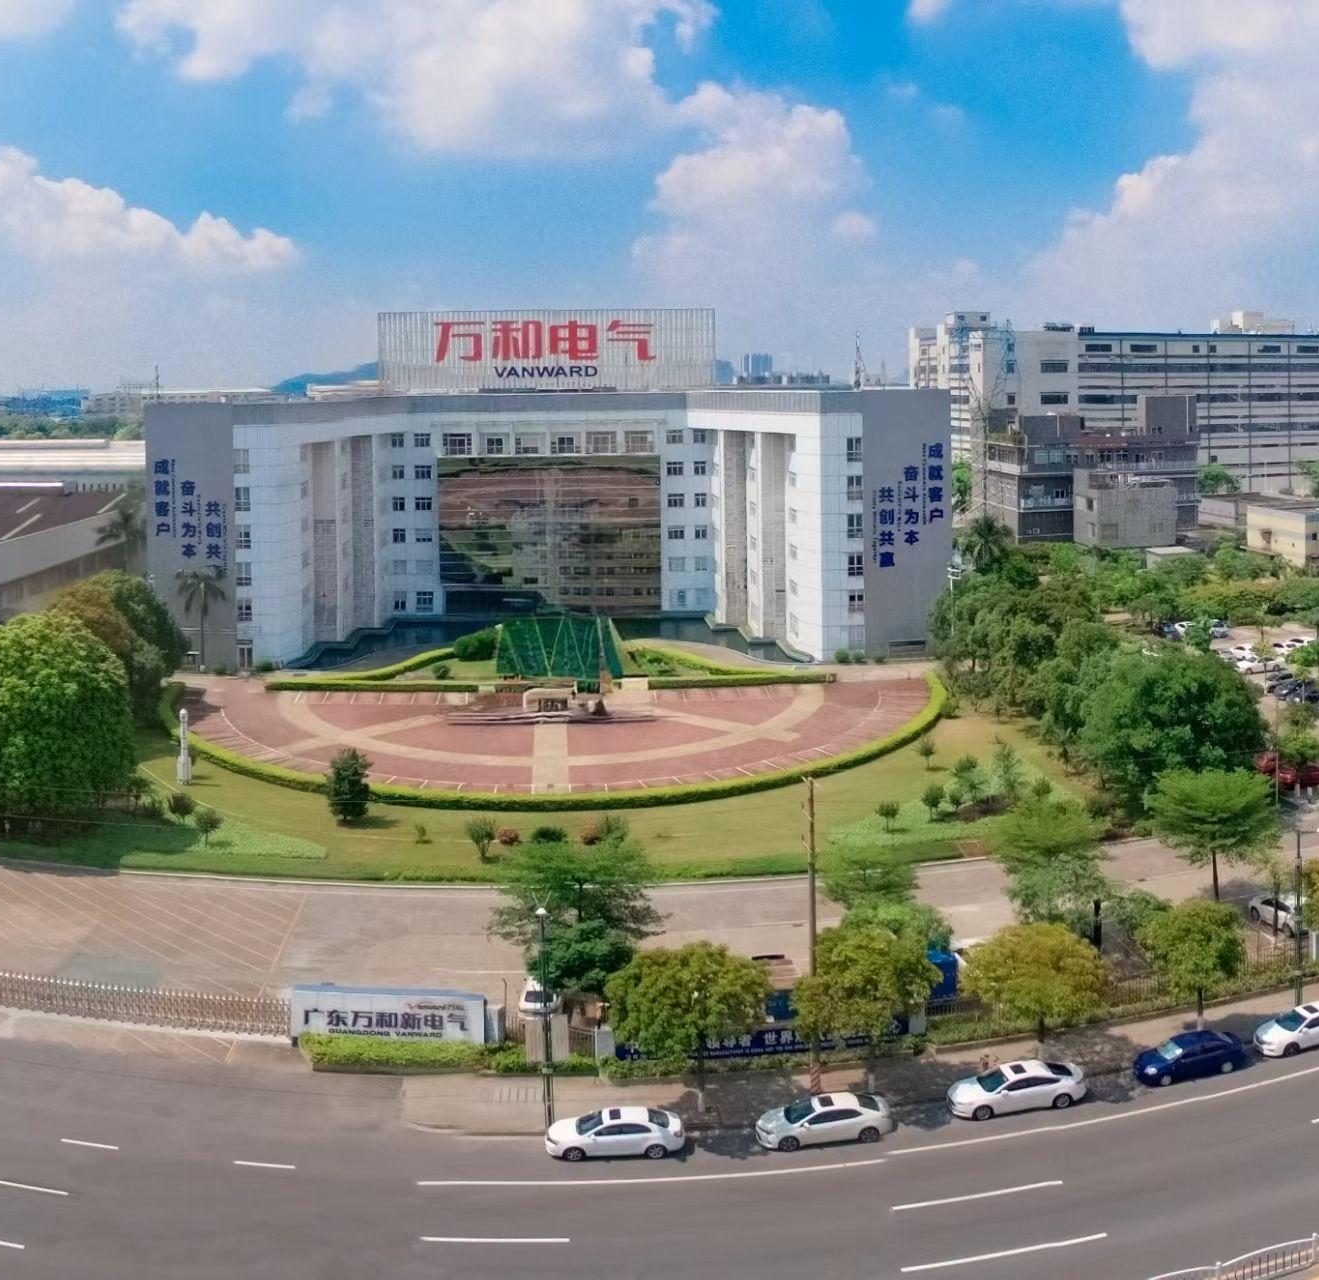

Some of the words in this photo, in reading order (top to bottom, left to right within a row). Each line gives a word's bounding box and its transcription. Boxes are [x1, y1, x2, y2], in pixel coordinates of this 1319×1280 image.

[434, 319, 657, 363] 万和电气
[495, 365, 598, 378] VANWARD
[154, 459, 170, 537] 成就客户
[180, 480, 197, 559] 奋斗为本
[903, 465, 919, 546] 奋斗为本
[928, 442, 944, 523] 成就客户
[205, 501, 222, 576] 共创共
[303, 1008, 469, 1031] 广东万和新电气
[328, 1028, 390, 1037] GUANGDONG
